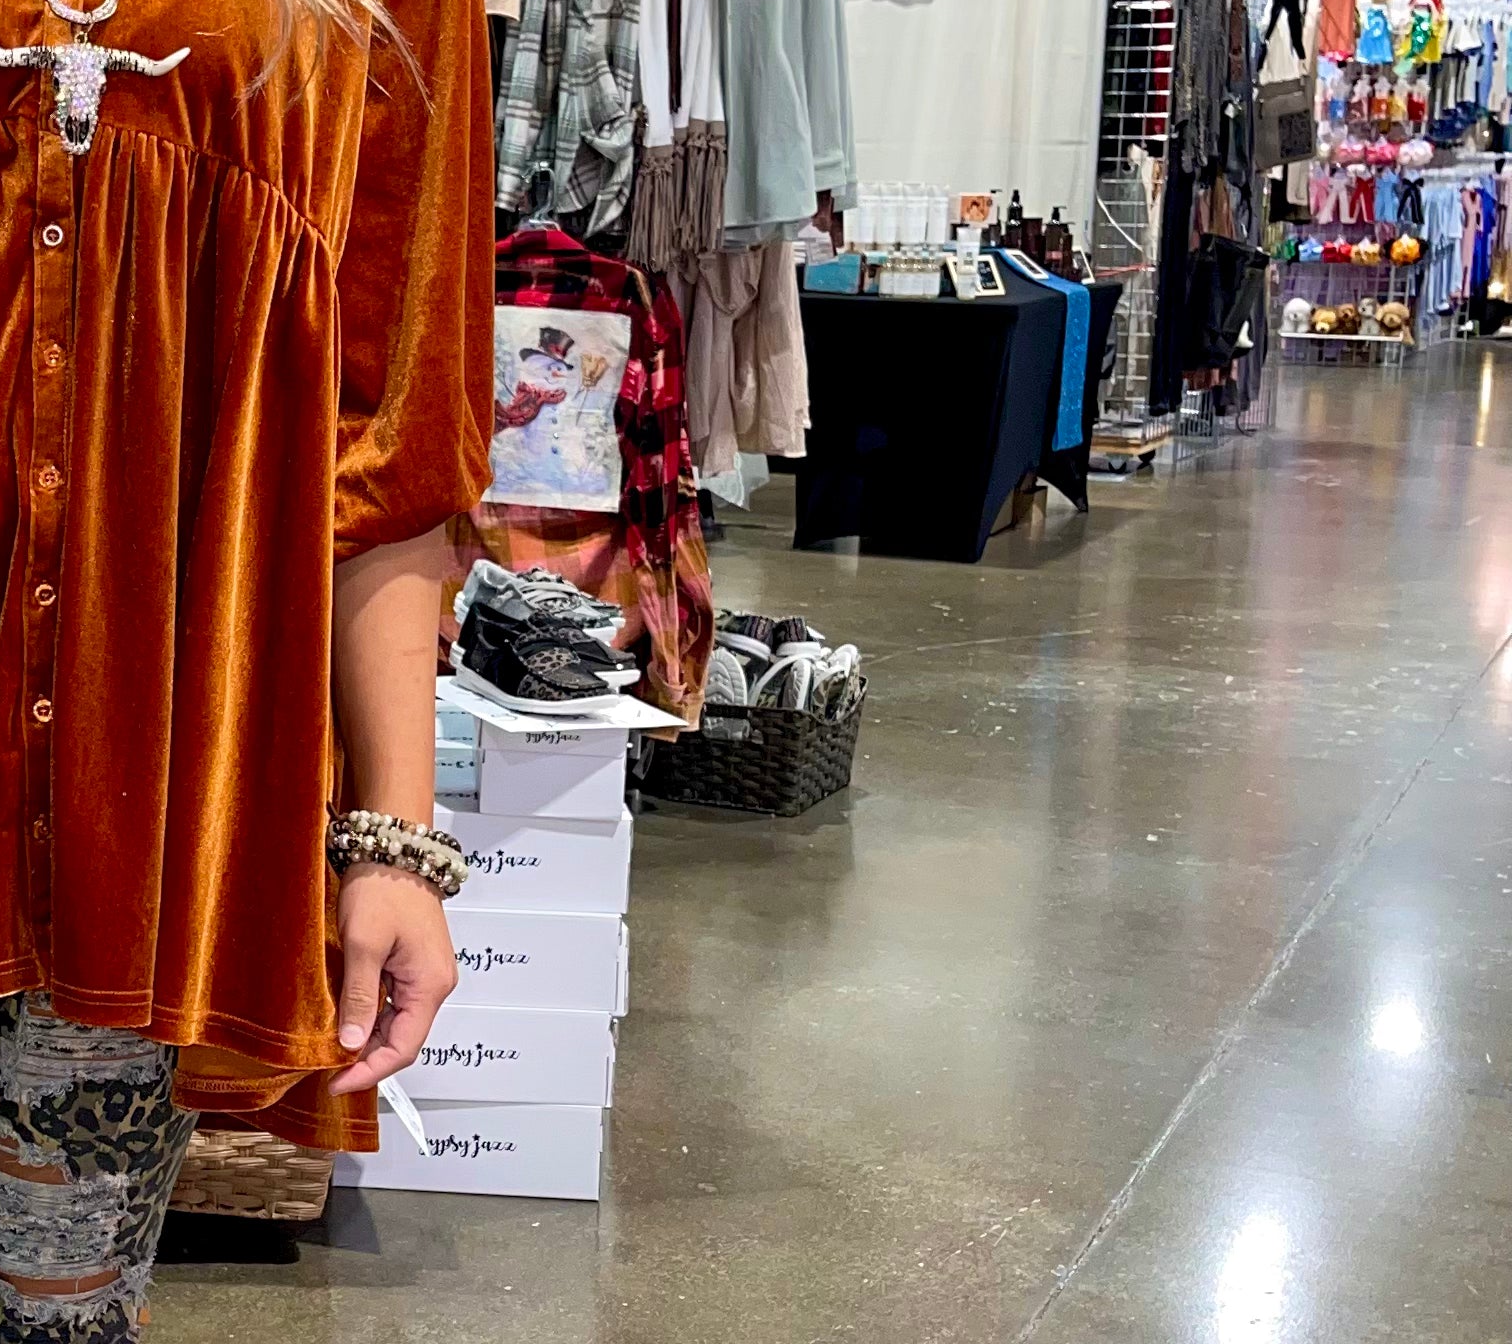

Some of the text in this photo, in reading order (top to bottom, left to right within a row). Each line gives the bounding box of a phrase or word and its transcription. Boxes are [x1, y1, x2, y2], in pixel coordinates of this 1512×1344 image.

[526, 730, 582, 745] gypsy jazz
[494, 848, 542, 874] jazz
[484, 946, 530, 971] jazz
[421, 1041, 520, 1067] gypsy jazz
[471, 1133, 517, 1158] jazz
